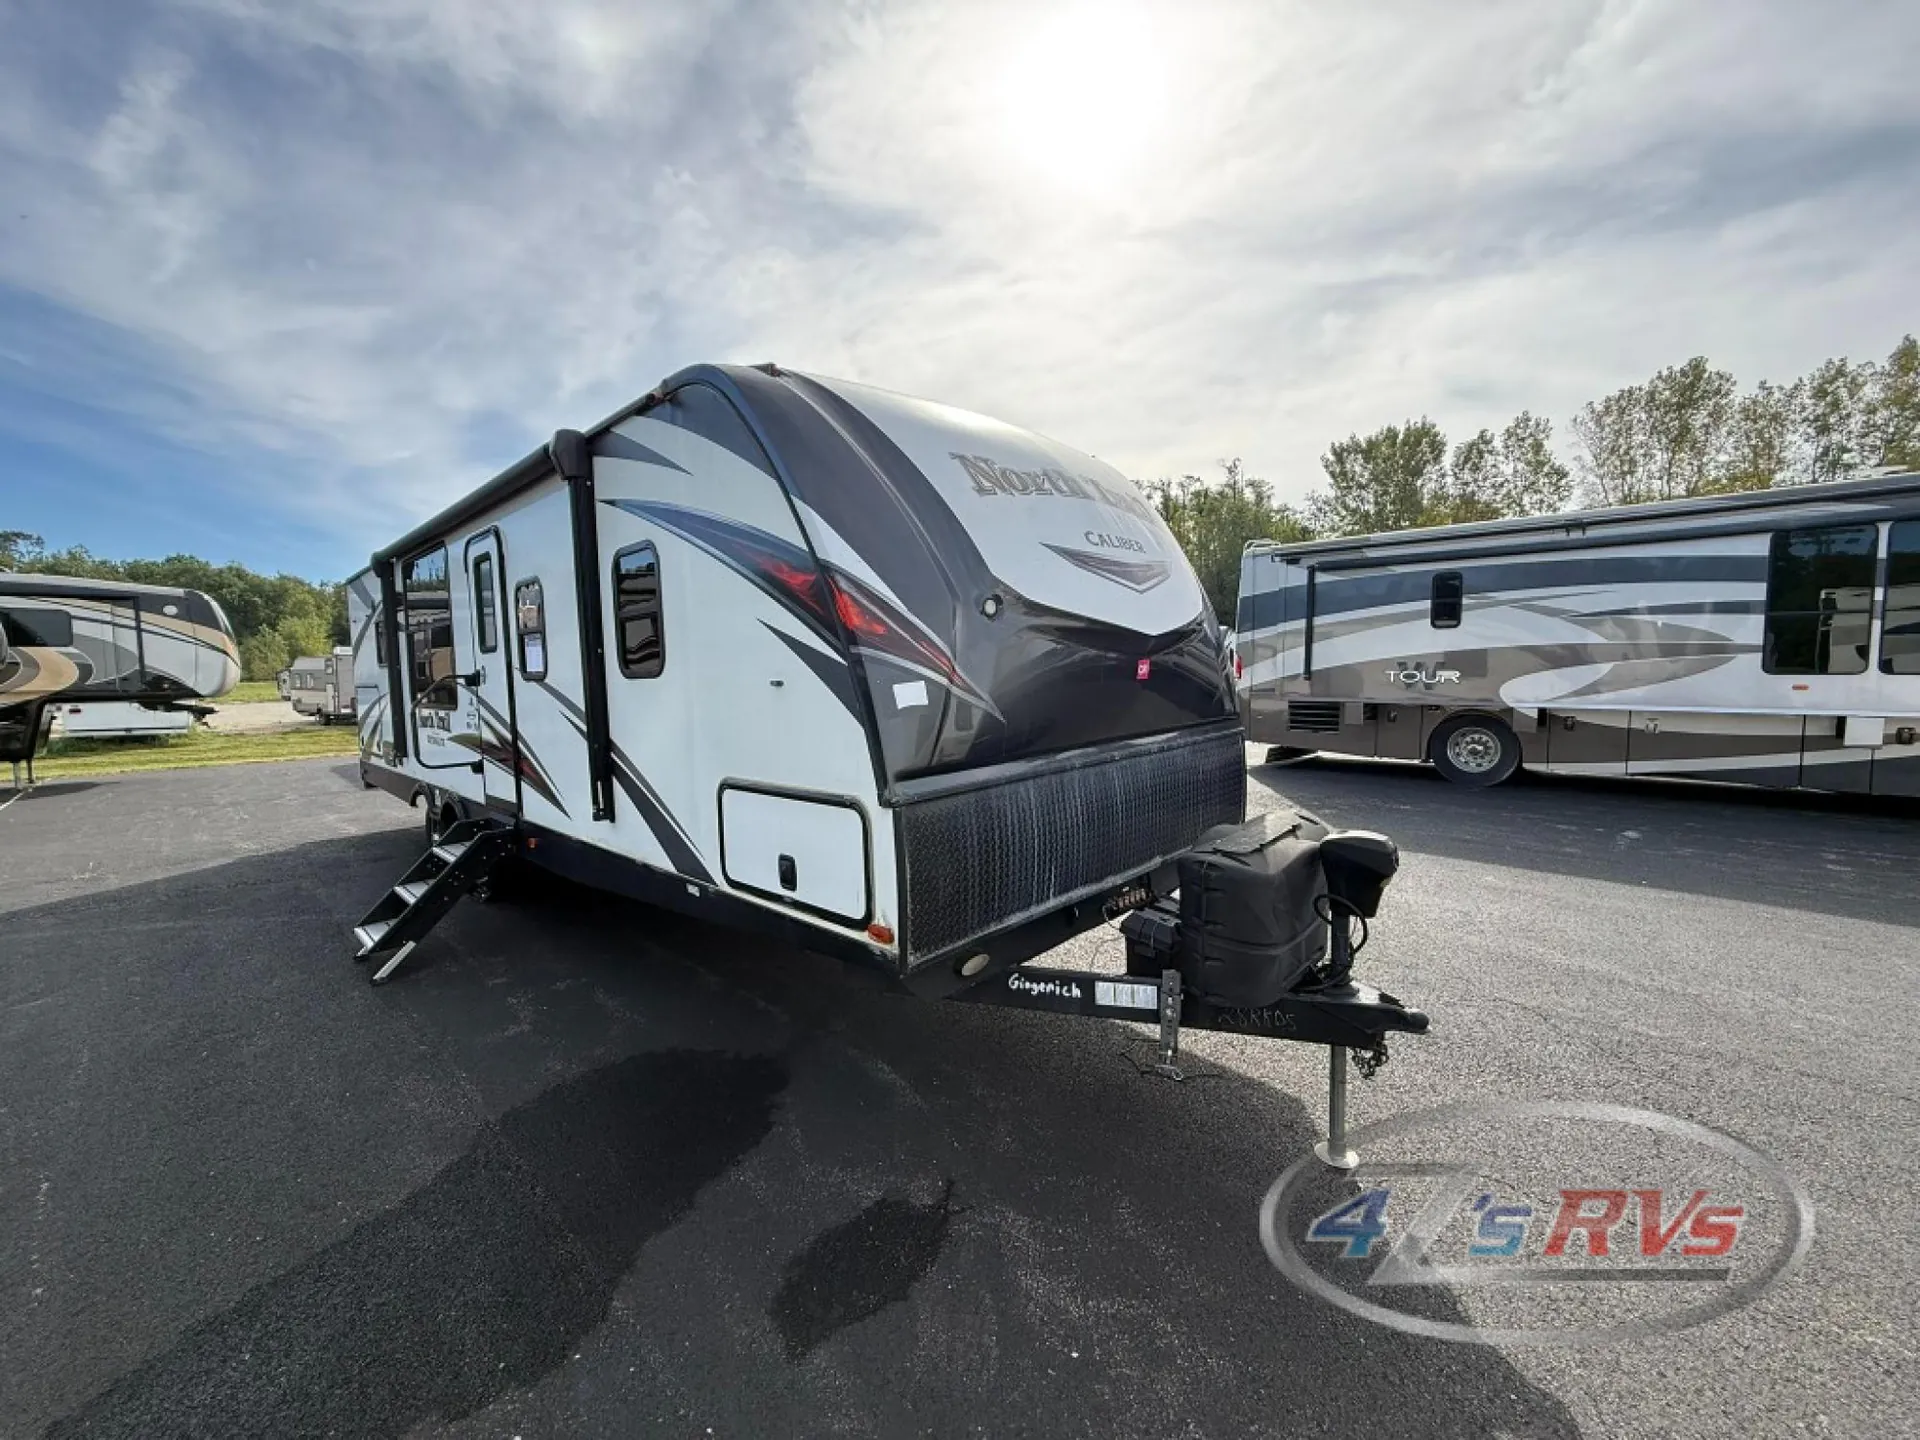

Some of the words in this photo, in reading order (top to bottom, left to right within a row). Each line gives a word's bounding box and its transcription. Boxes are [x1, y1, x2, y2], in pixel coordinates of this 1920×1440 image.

[1084, 530, 1146, 554] CALIBER
[1384, 670, 1460, 684] TOUR
[1008, 972, 1082, 999] Gingerich
